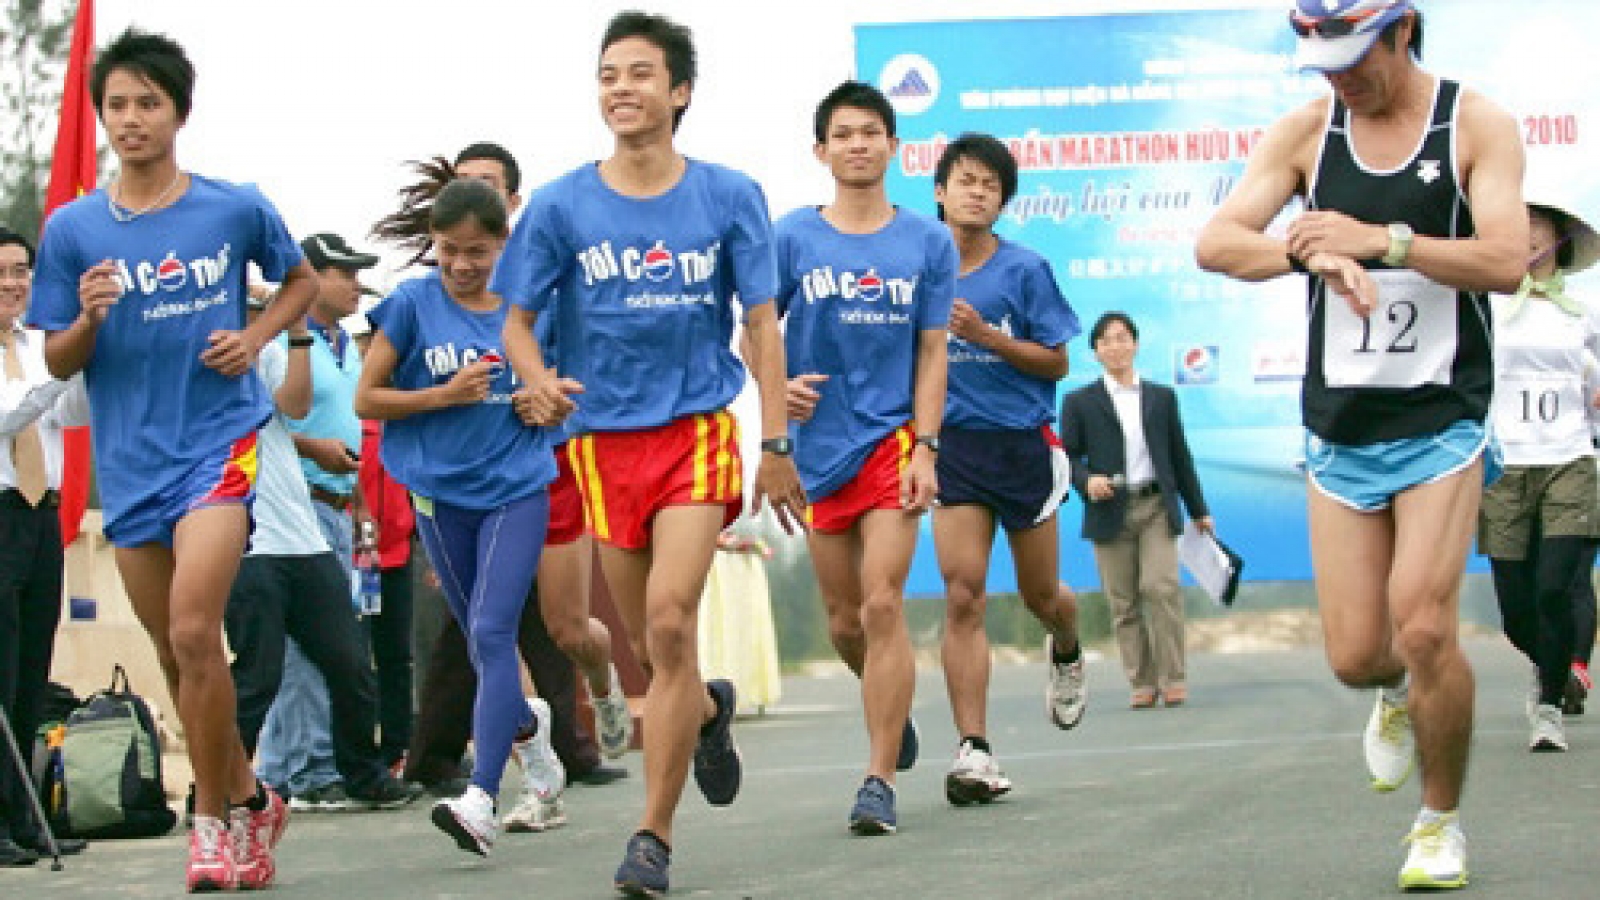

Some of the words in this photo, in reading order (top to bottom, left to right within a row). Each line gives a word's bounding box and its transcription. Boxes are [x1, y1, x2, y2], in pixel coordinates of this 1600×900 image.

[901, 134, 947, 172] CU
[1059, 132, 1179, 167] MARATHON
[1522, 114, 1578, 145] 2010
[1350, 299, 1420, 353] 12
[1518, 390, 1560, 423] 10
